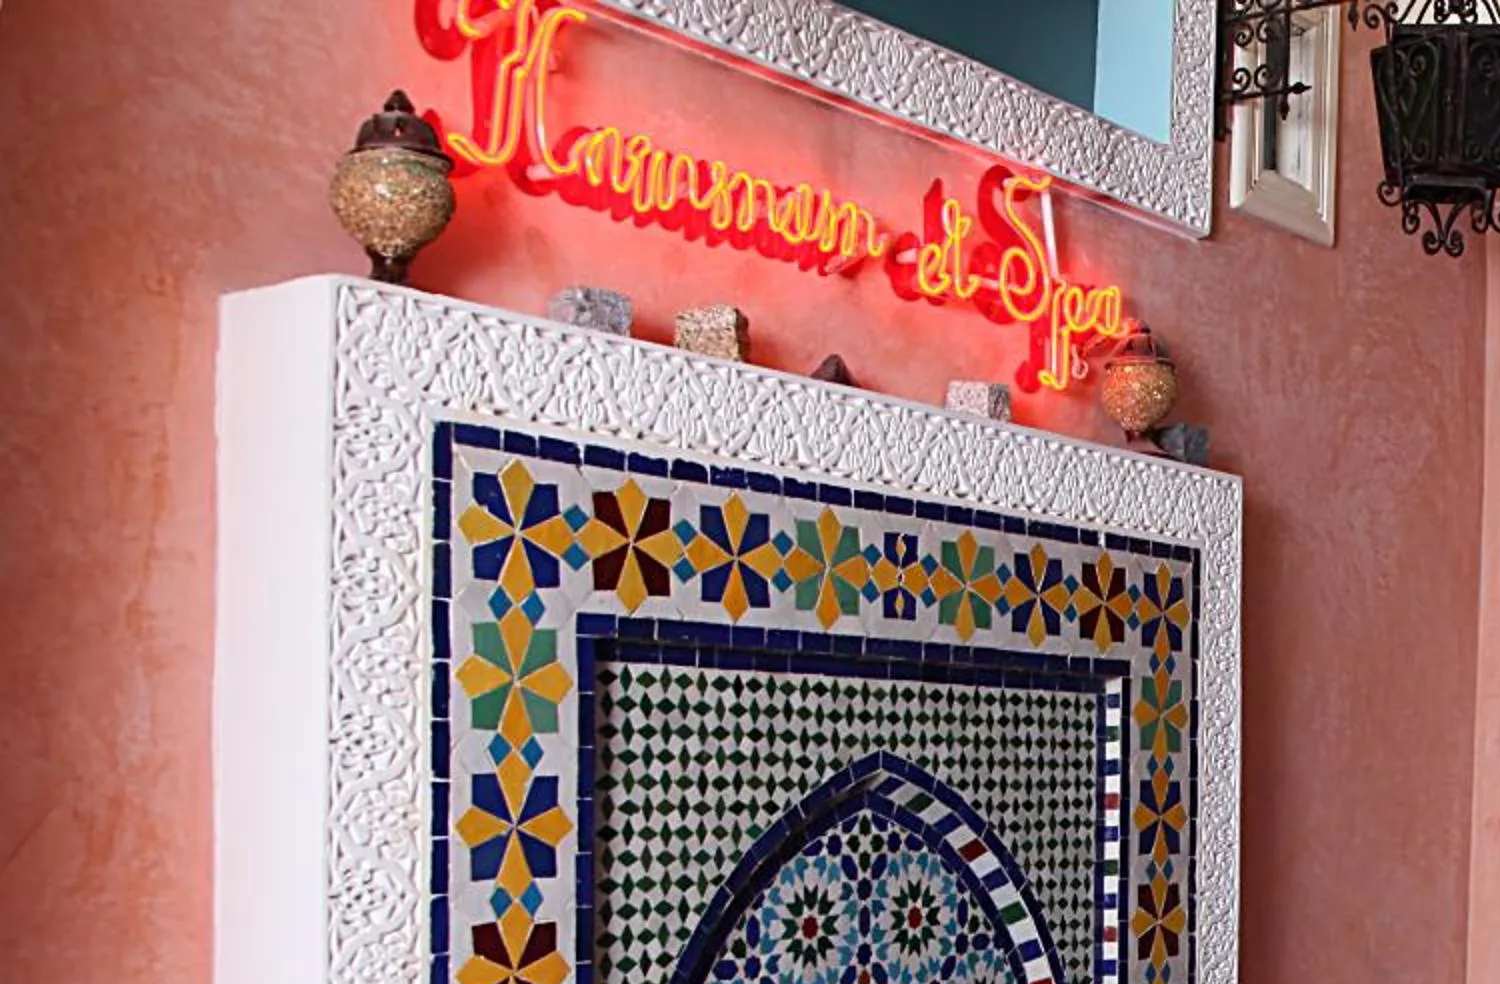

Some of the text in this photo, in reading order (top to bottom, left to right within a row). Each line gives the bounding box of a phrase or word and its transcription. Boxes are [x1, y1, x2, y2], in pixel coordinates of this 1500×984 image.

[447, 0, 1127, 391] Hammam et Spa
